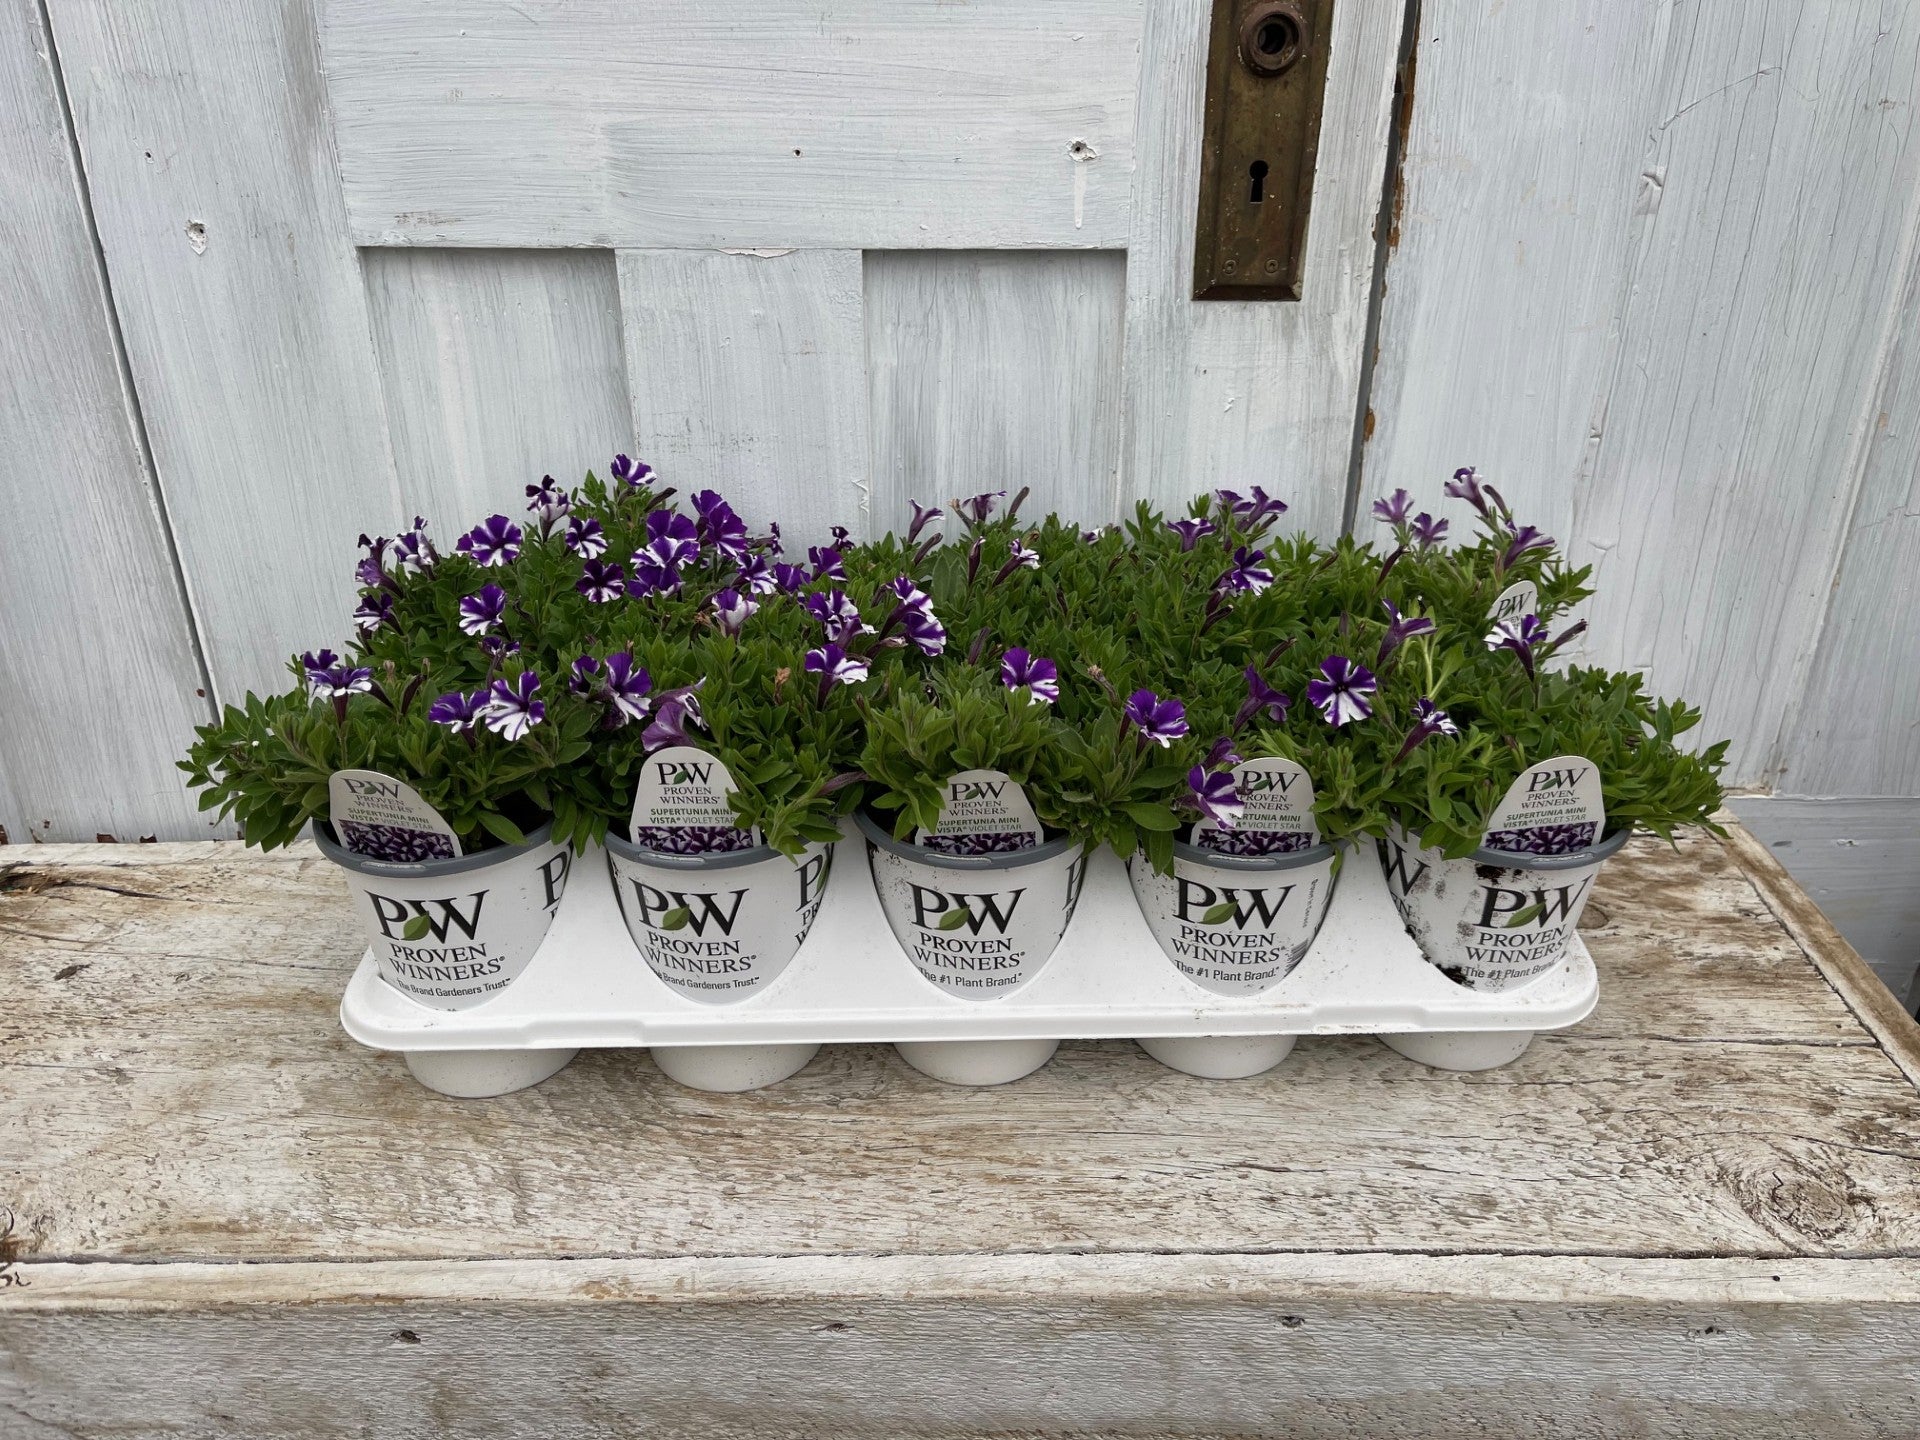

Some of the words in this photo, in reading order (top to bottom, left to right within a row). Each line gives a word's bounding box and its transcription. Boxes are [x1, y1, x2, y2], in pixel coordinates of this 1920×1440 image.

[654, 763, 714, 785] PW
[1240, 771, 1300, 793] PW
[1525, 767, 1590, 792] PW
[340, 778, 399, 799] PW
[664, 787, 712, 795] PROVEN
[950, 781, 1008, 801] PW
[1527, 789, 1575, 801] PROVEN
[355, 794, 405, 806] PROVEN
[954, 800, 1002, 809] PROVEN
[1243, 802, 1290, 811] INNERS
[348, 808, 406, 820] SUPERTUNIA
[408, 816, 429, 824] MINI
[938, 818, 996, 826] SUPERTUNIA
[1280, 814, 1301, 822] MINI
[1506, 809, 1563, 821] SUPERTUNIA
[1564, 806, 1587, 815] MINI
[1534, 816, 1564, 825] VIOLET
[1565, 813, 1586, 822] STAR
[381, 819, 410, 827] VIOLET
[412, 822, 433, 831] STAR
[1000, 823, 1022, 831] STAR
[1280, 822, 1301, 830] STAR
[629, 877, 749, 937] PW
[906, 881, 1027, 936] PW
[1173, 876, 1297, 930] PW
[1472, 873, 1594, 928] PW
[363, 889, 490, 944] PW
[647, 930, 740, 957] PROVEN
[920, 931, 1013, 954] PROVEN
[1180, 924, 1276, 948] PROVEN
[1477, 924, 1567, 948] PROVEN
[389, 943, 487, 963] PROVEN
[919, 967, 936, 982] The
[940, 974, 951, 984] #1
[955, 976, 983, 987] Plant
[1174, 960, 1194, 974] The
[1197, 968, 1209, 978] #1
[1213, 970, 1241, 981] Plant
[1465, 966, 1485, 978] The
[1504, 968, 1531, 978] Plant
[410, 984, 434, 996] Brand
[436, 985, 482, 997] Gardeners
[663, 972, 685, 986] Brand
[686, 979, 731, 990] Gardeners
